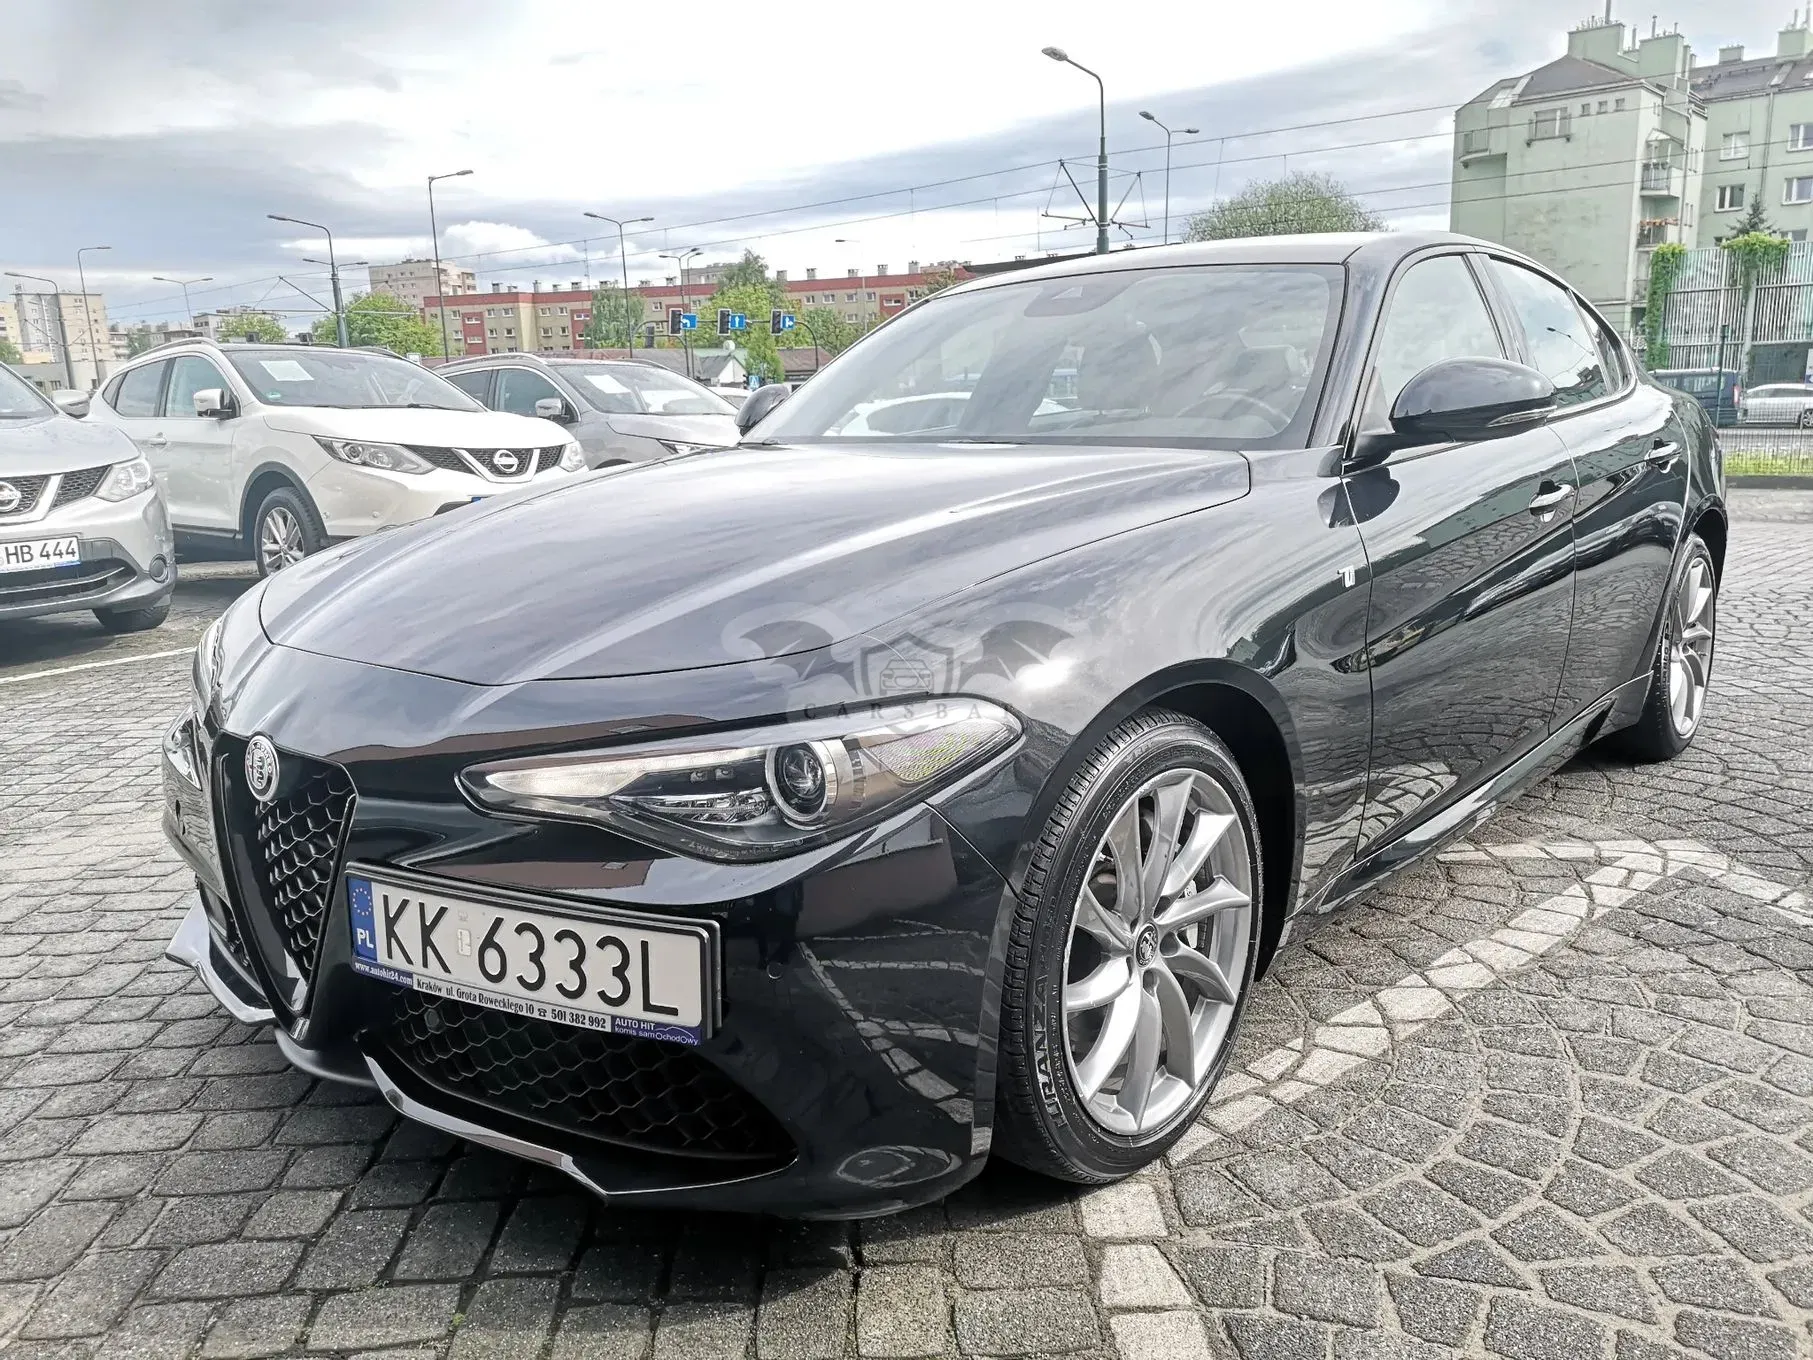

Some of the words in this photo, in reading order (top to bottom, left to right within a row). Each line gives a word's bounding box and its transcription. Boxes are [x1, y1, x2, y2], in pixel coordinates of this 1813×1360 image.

[4, 545, 34, 565] HB
[40, 540, 77, 560] 444
[356, 927, 374, 949] PL
[382, 893, 452, 974] KK
[478, 916, 679, 1016] 6333L
[354, 961, 414, 986] www.autohit24.com
[416, 978, 442, 994] Kraków
[445, 986, 456, 998] ul.
[456, 988, 477, 1002] Grota
[525, 1003, 535, 1016] 10
[551, 1008, 568, 1021] 501
[568, 1013, 587, 1026] 382
[588, 1017, 607, 1029] 992
[615, 1017, 639, 1029] AUTO
[640, 1021, 656, 1032] HIT
